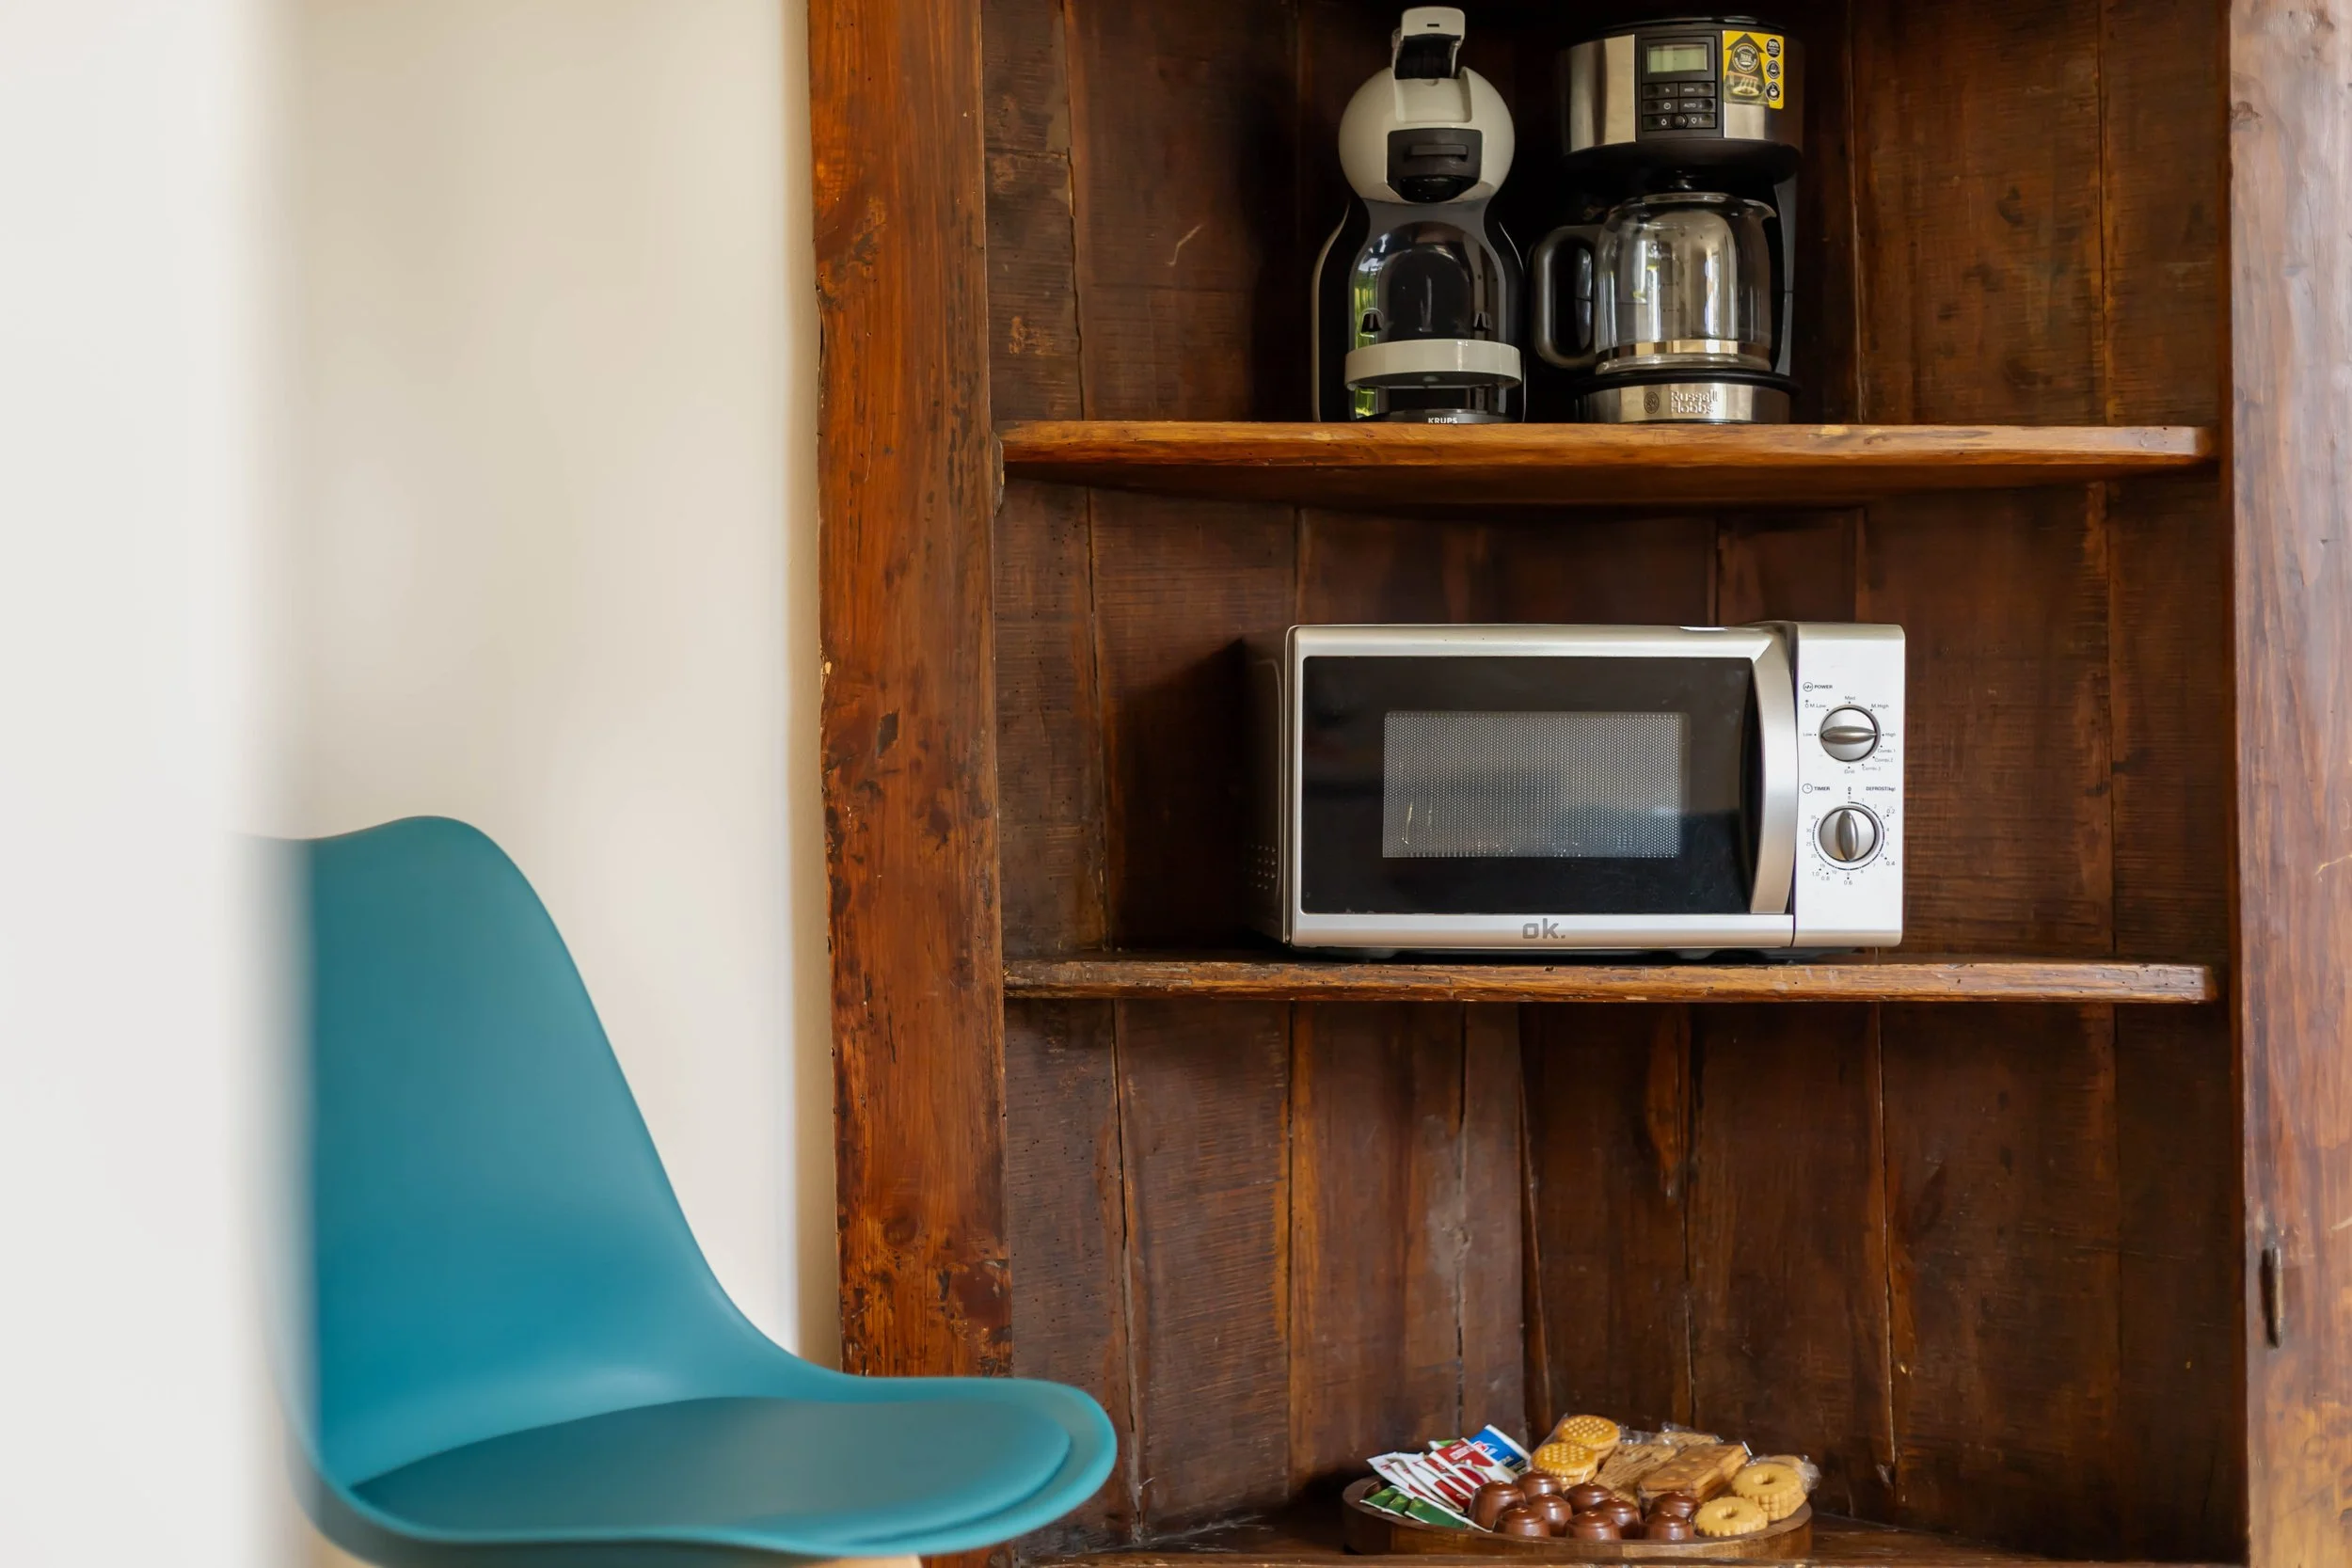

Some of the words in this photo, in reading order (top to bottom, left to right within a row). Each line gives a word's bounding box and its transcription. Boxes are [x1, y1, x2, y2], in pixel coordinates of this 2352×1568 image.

[1672, 388, 1718, 403] Russell
[1672, 401, 1713, 414] Hobbs
[1522, 917, 1565, 939] ok.
